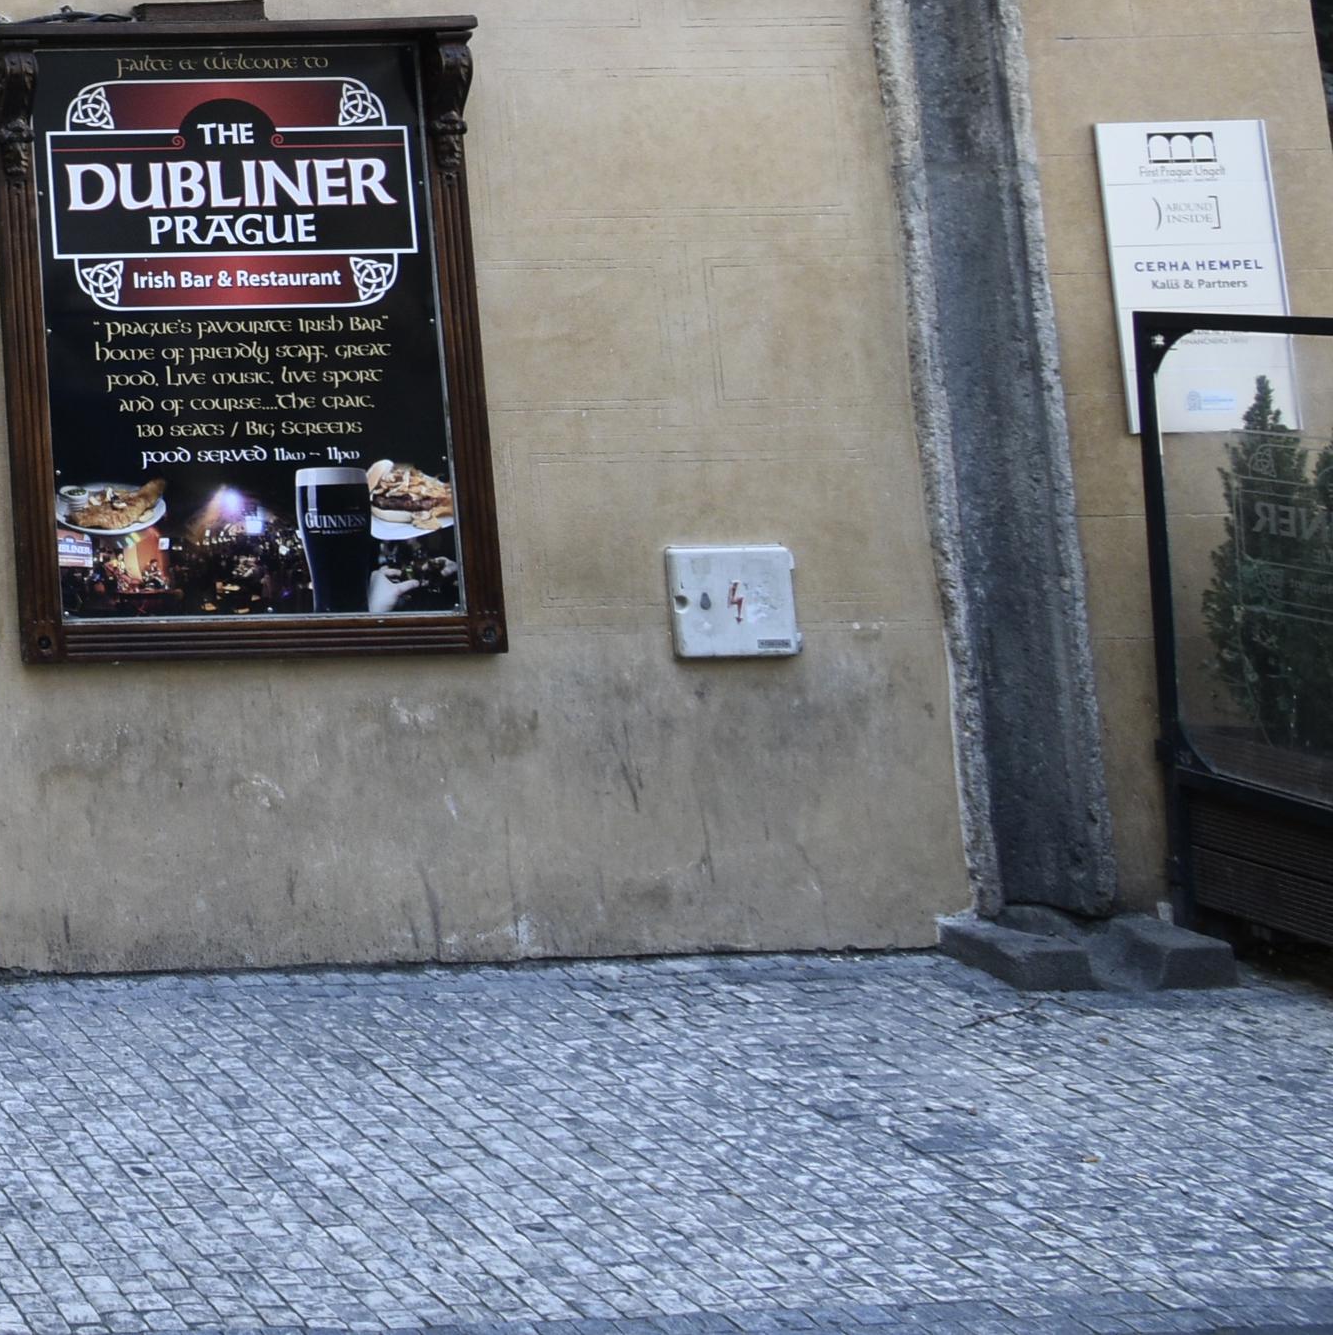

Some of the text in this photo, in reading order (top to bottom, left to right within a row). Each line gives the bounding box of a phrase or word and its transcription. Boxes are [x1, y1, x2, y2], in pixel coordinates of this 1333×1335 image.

[197, 122, 255, 146] THE
[65, 156, 397, 213] DUBLINER
[1166, 203, 1213, 212] AROUND
[1167, 215, 1214, 223] INSIDE
[149, 211, 317, 246] PRAGUE
[1135, 259, 1263, 272] CERHA HEMPEL
[132, 268, 342, 290] Irish Bar & Restaurant
[1184, 279, 1194, 289] &
[1198, 278, 1247, 288] Partners
[137, 423, 164, 437] 130
[231, 421, 239, 437] /
[305, 512, 366, 529] GUINNESS
